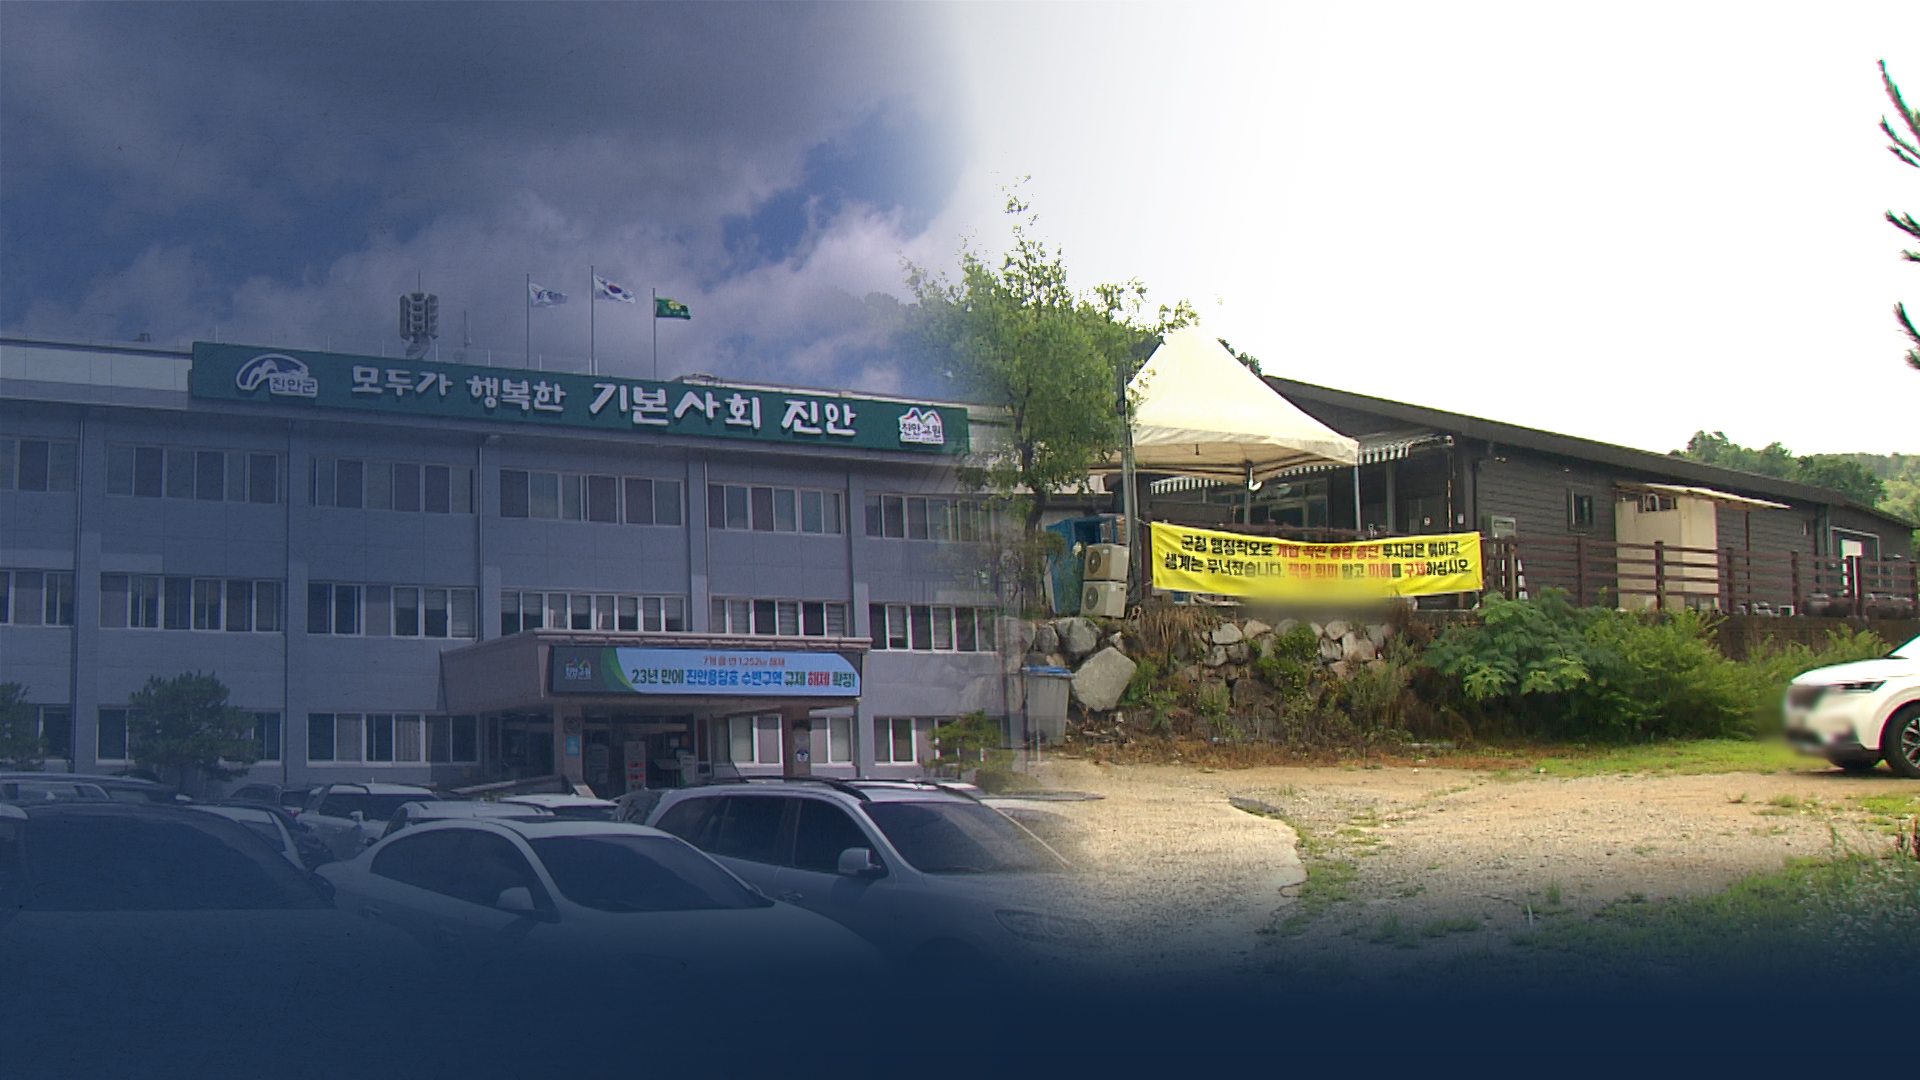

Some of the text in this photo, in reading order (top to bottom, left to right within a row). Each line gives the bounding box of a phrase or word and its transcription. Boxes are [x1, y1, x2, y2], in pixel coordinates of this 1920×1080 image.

[271, 376, 316, 396] 진안군
[352, 364, 857, 437] 모두가 행복한 기본사회 진안
[901, 422, 942, 438] 진안고원
[1181, 534, 1207, 552] 군청
[1210, 537, 1274, 557] 행정착오로
[1383, 543, 1425, 559] 투자금은
[1165, 552, 1204, 572] 생계는
[1207, 558, 1285, 577] 무너졌습니다.
[631, 668, 658, 684] 23년
[661, 668, 684, 685] 만에
[686, 668, 739, 686] 진안용담호
[741, 669, 782, 686] 수변구역
[784, 670, 806, 687] 규제
[807, 671, 829, 687] 해제
